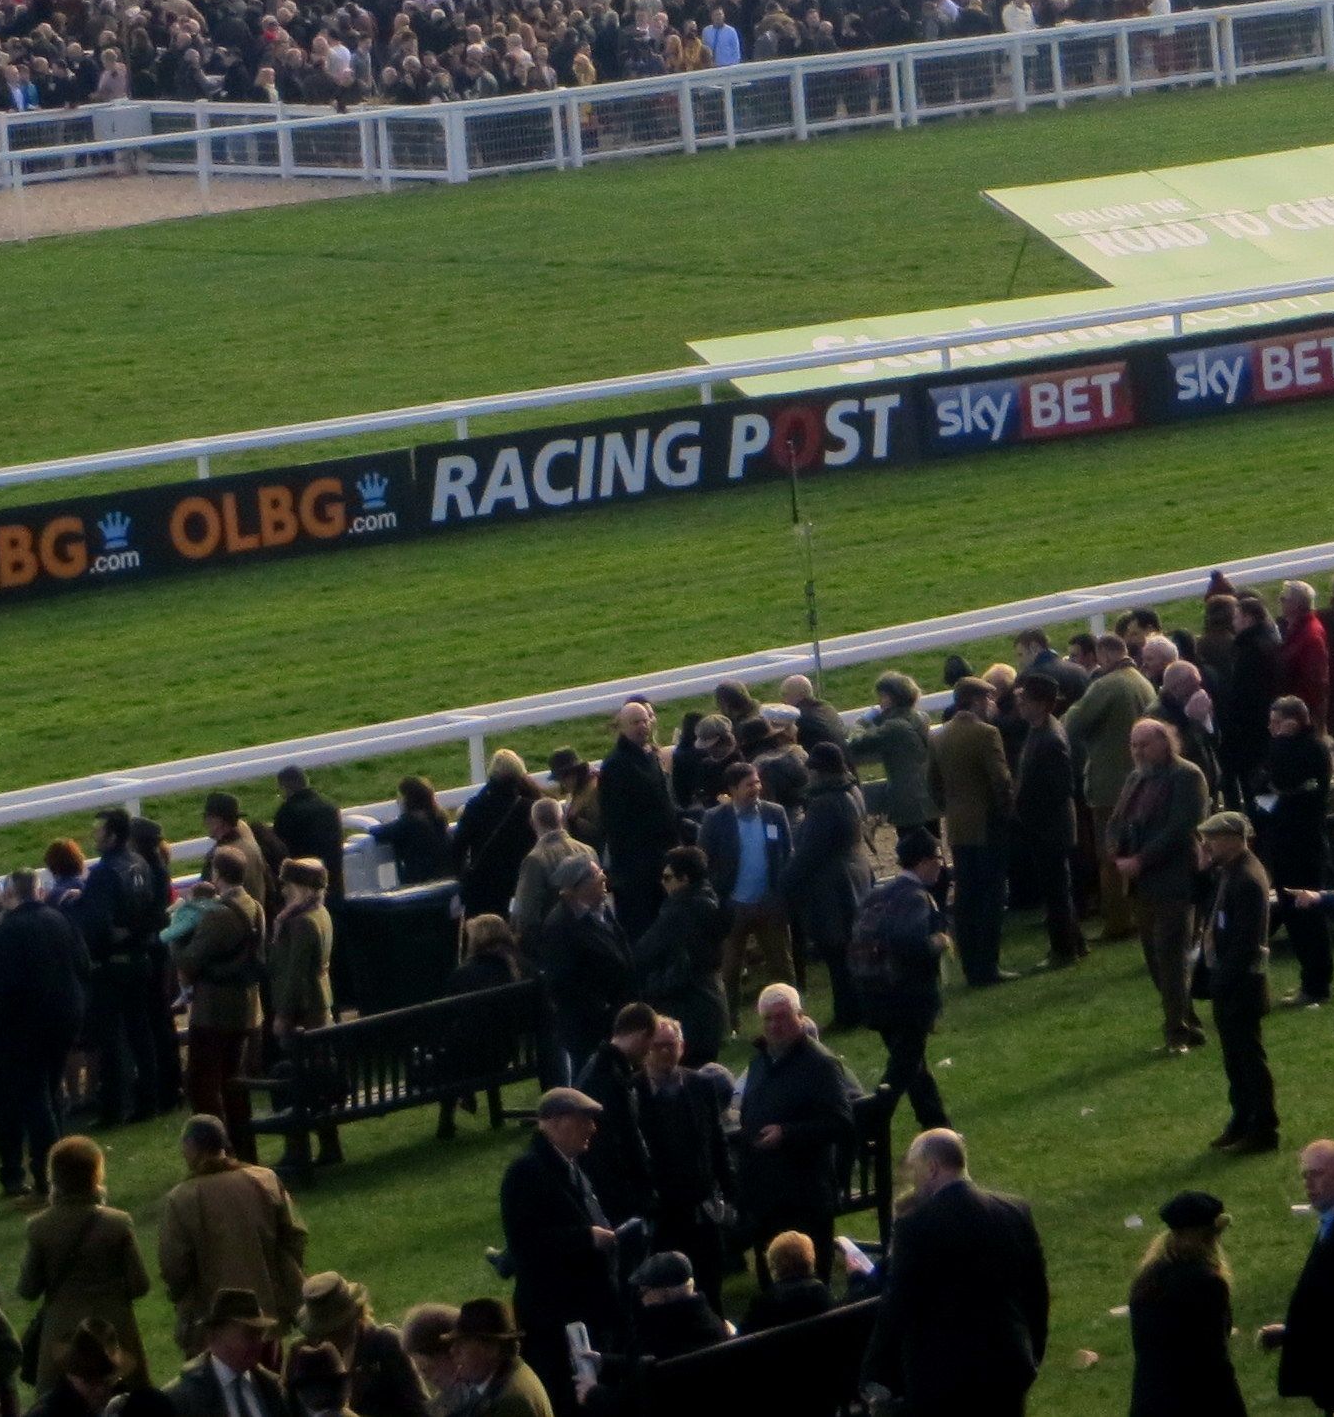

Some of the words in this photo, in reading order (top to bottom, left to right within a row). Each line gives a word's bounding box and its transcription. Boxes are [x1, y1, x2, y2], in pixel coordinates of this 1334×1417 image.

[1078, 219, 1210, 257] ROAD
[1195, 209, 1273, 239] TO
[937, 386, 1011, 441] sky
[1030, 372, 1121, 428] BET
[1175, 351, 1244, 404] sky
[432, 421, 702, 521] RACING
[728, 394, 901, 478] POST
